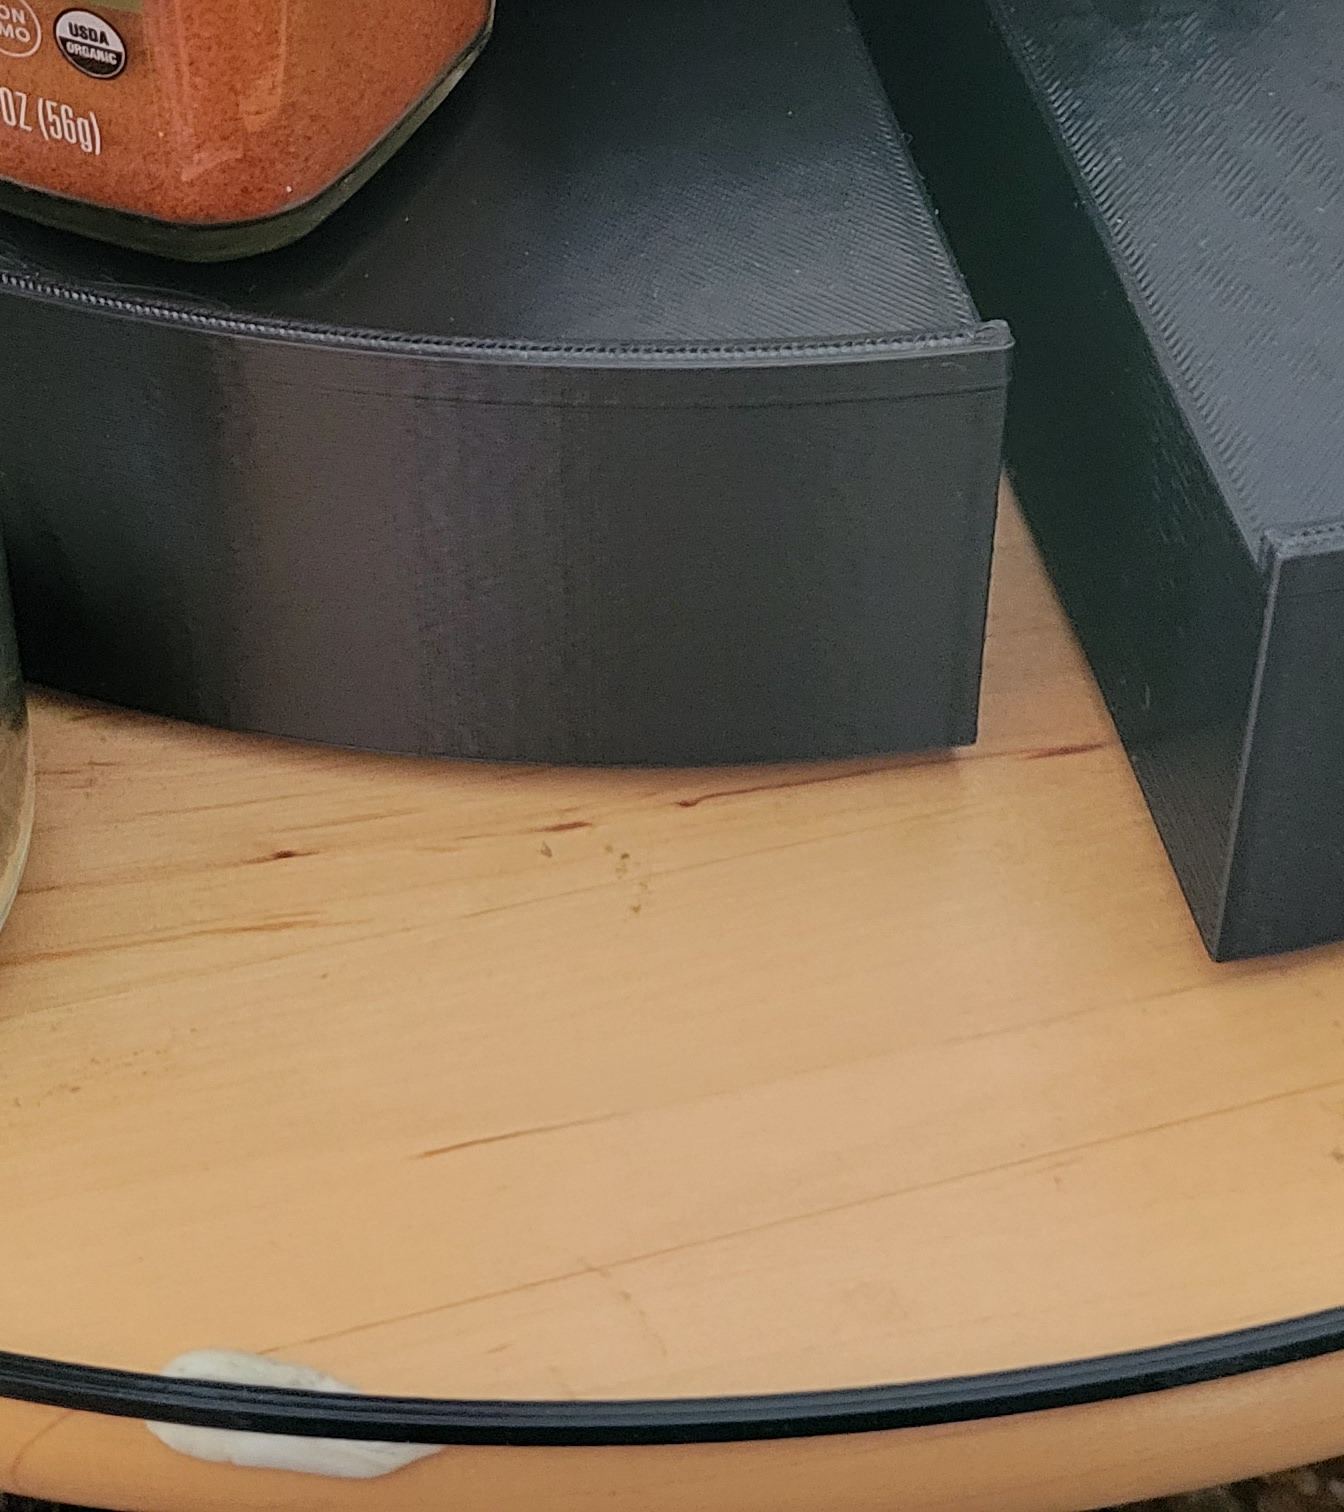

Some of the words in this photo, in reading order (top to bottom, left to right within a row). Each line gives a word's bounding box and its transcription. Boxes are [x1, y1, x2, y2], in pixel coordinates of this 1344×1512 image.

[68, 21, 111, 47] USDA
[66, 41, 118, 67] ORGANIC
[0, 88, 32, 132] OZ
[37, 97, 102, 156] (56g)
